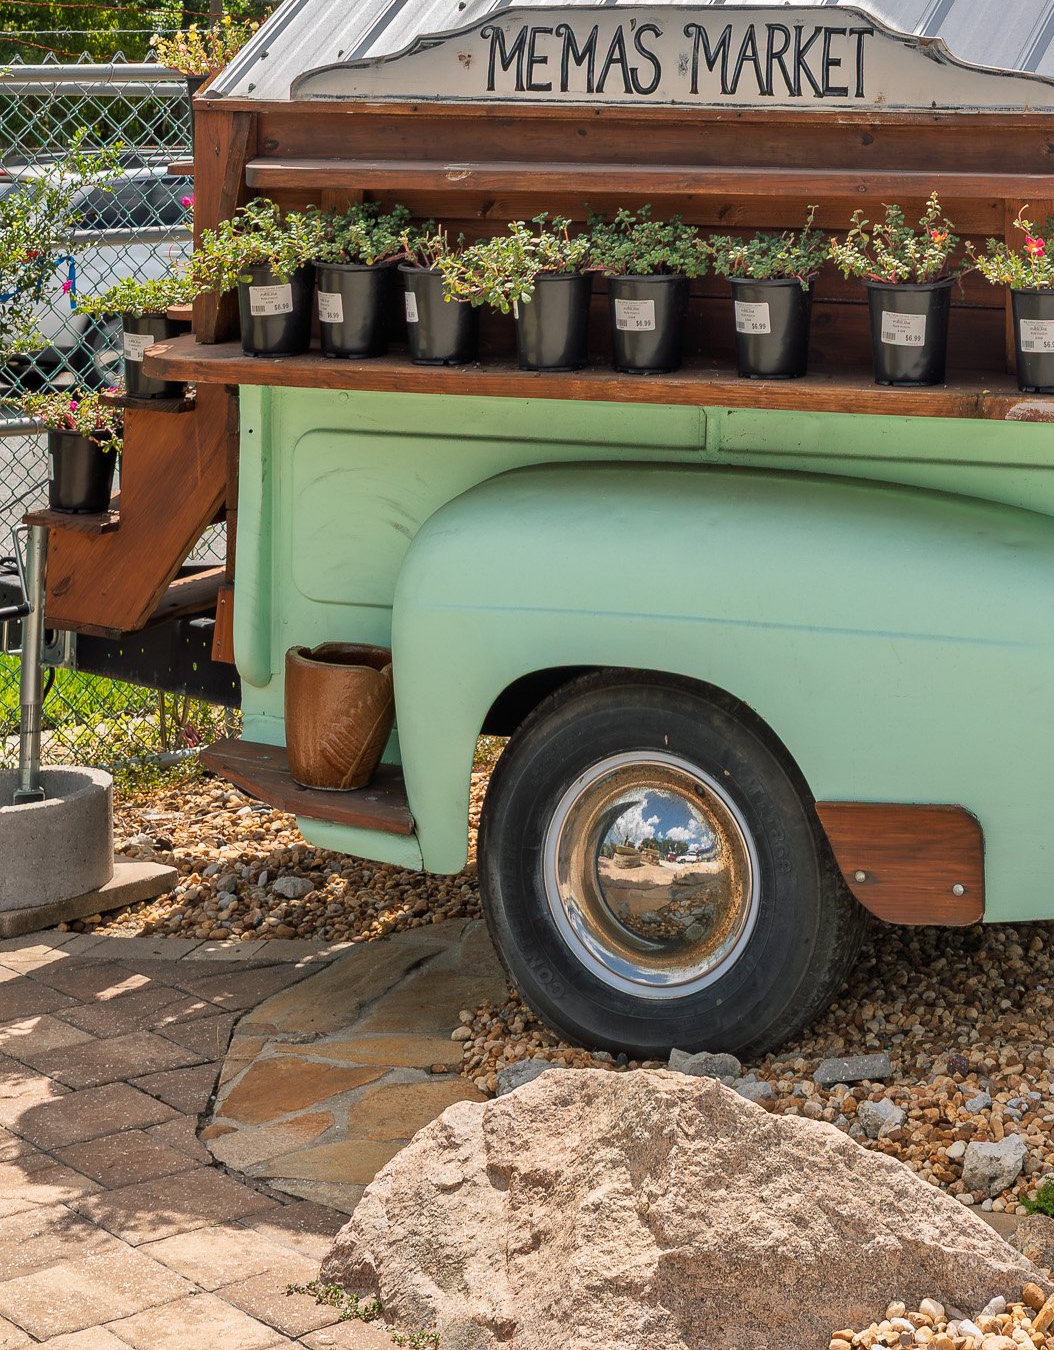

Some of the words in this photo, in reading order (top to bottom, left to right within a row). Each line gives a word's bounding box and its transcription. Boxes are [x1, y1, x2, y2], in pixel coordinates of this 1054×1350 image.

[480, 18, 664, 96] MEMA'S
[683, 22, 874, 99] MARKET
[274, 302, 290, 311] $6.99
[751, 322, 767, 330] $6.99
[905, 334, 921, 342] $6.99
